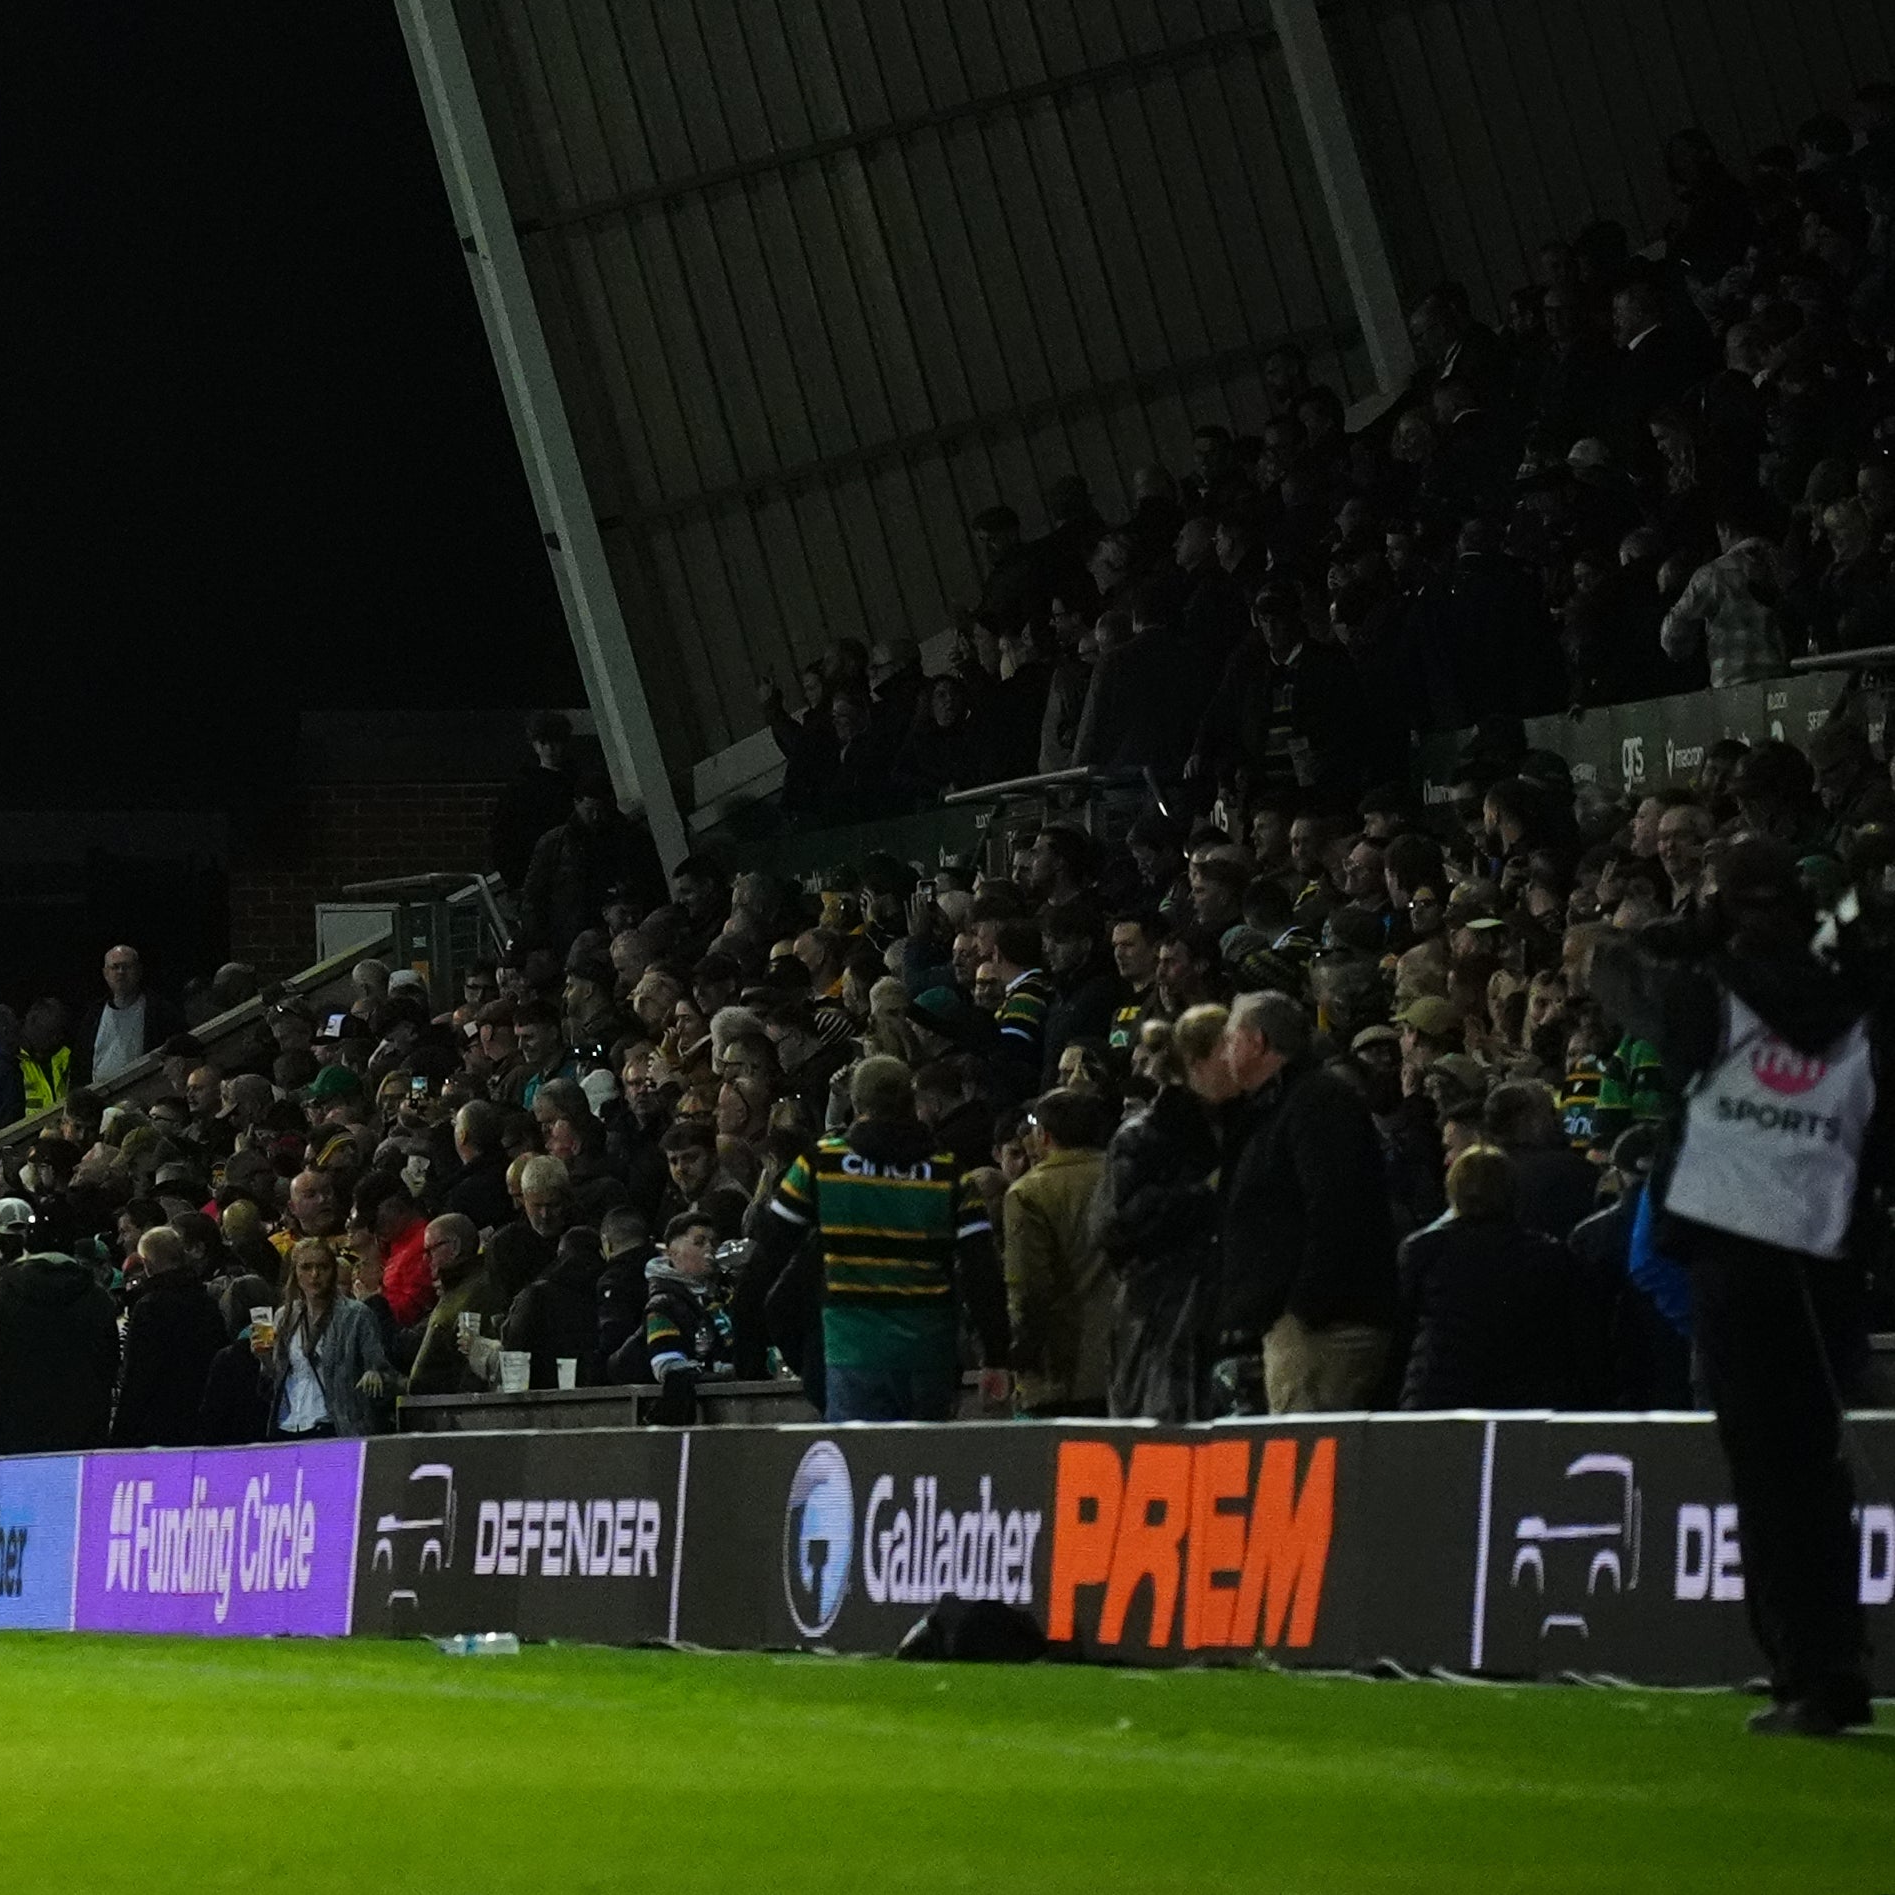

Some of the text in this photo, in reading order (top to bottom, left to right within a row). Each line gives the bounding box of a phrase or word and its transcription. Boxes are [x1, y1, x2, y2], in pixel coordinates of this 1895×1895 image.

[1717, 1096, 1842, 1143] SPORTS
[105, 1467, 315, 1625] #Funding Circle
[474, 1500, 662, 1578] DEFENDER
[863, 1473, 1042, 1606] Gallagher
[1047, 1436, 1338, 1651] PREM
